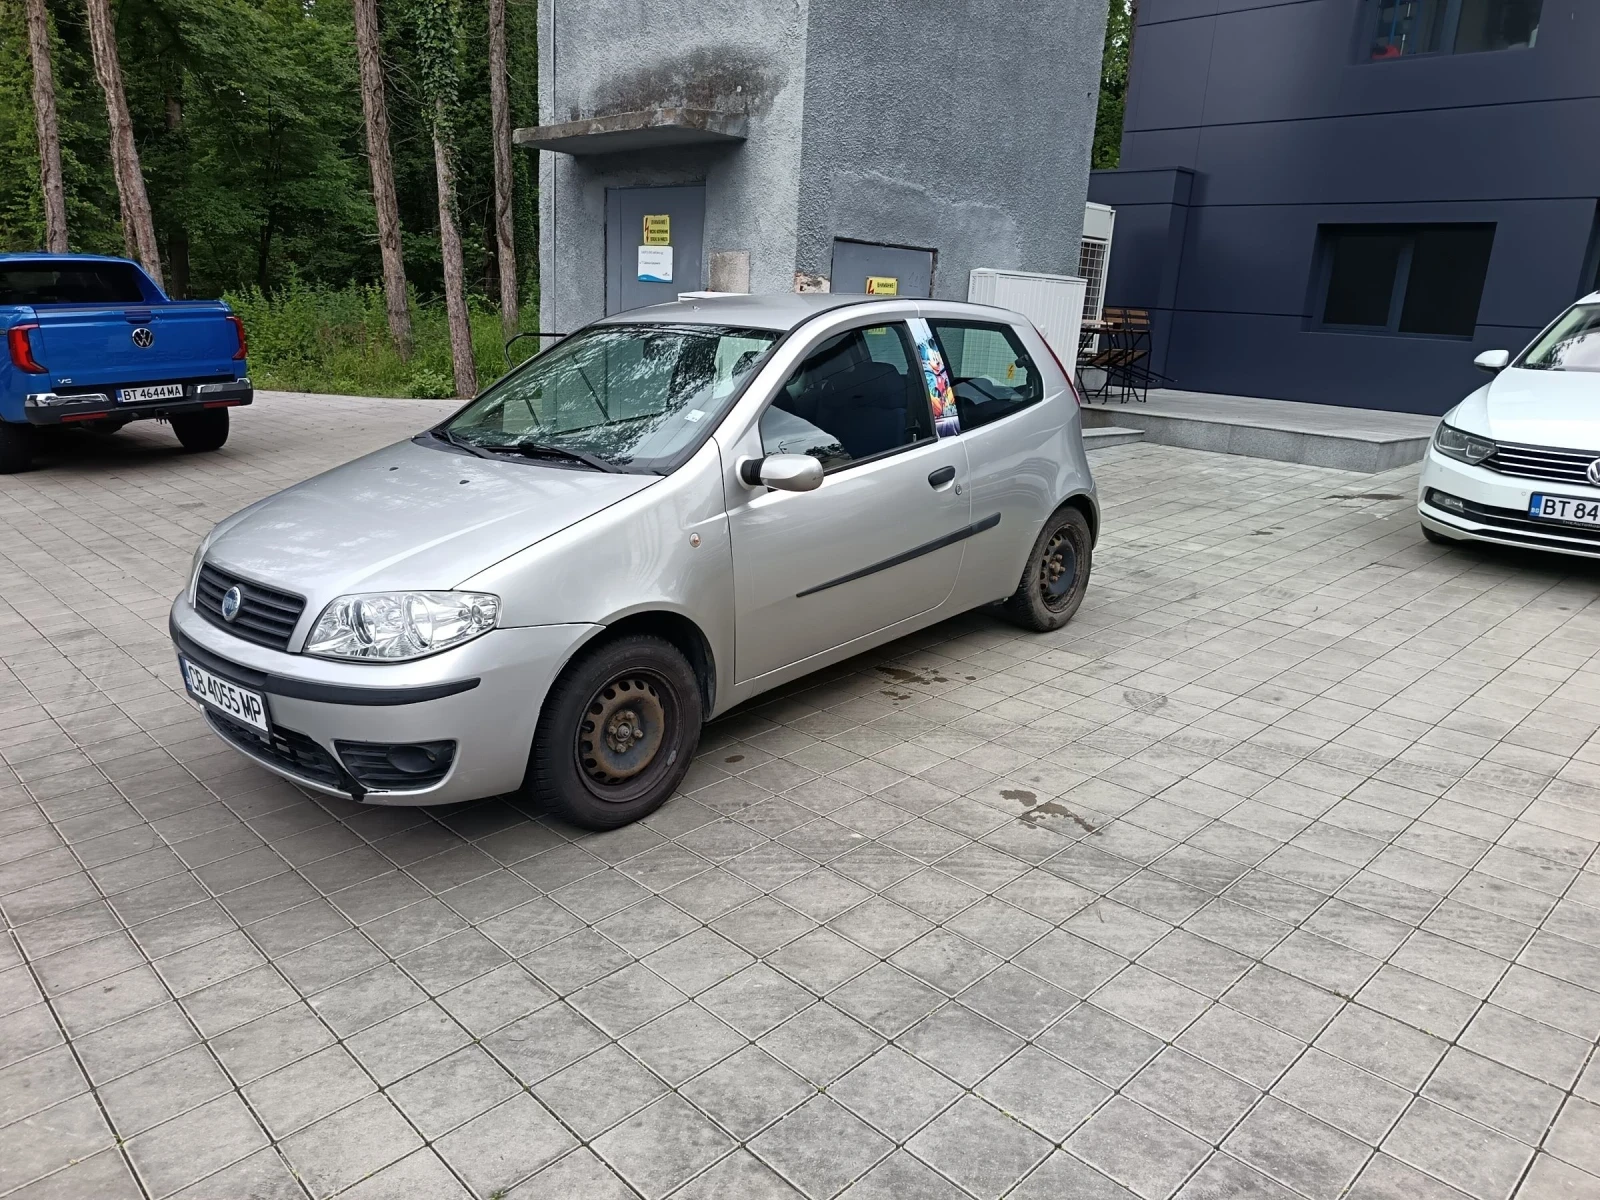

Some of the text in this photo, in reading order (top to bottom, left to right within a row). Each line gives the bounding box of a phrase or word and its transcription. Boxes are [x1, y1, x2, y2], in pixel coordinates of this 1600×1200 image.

[123, 386, 181, 400] BT 4644 MA
[1543, 499, 1599, 521] BT 84
[188, 666, 207, 696] CB
[207, 677, 240, 714] 4055
[239, 691, 262, 723] MP
